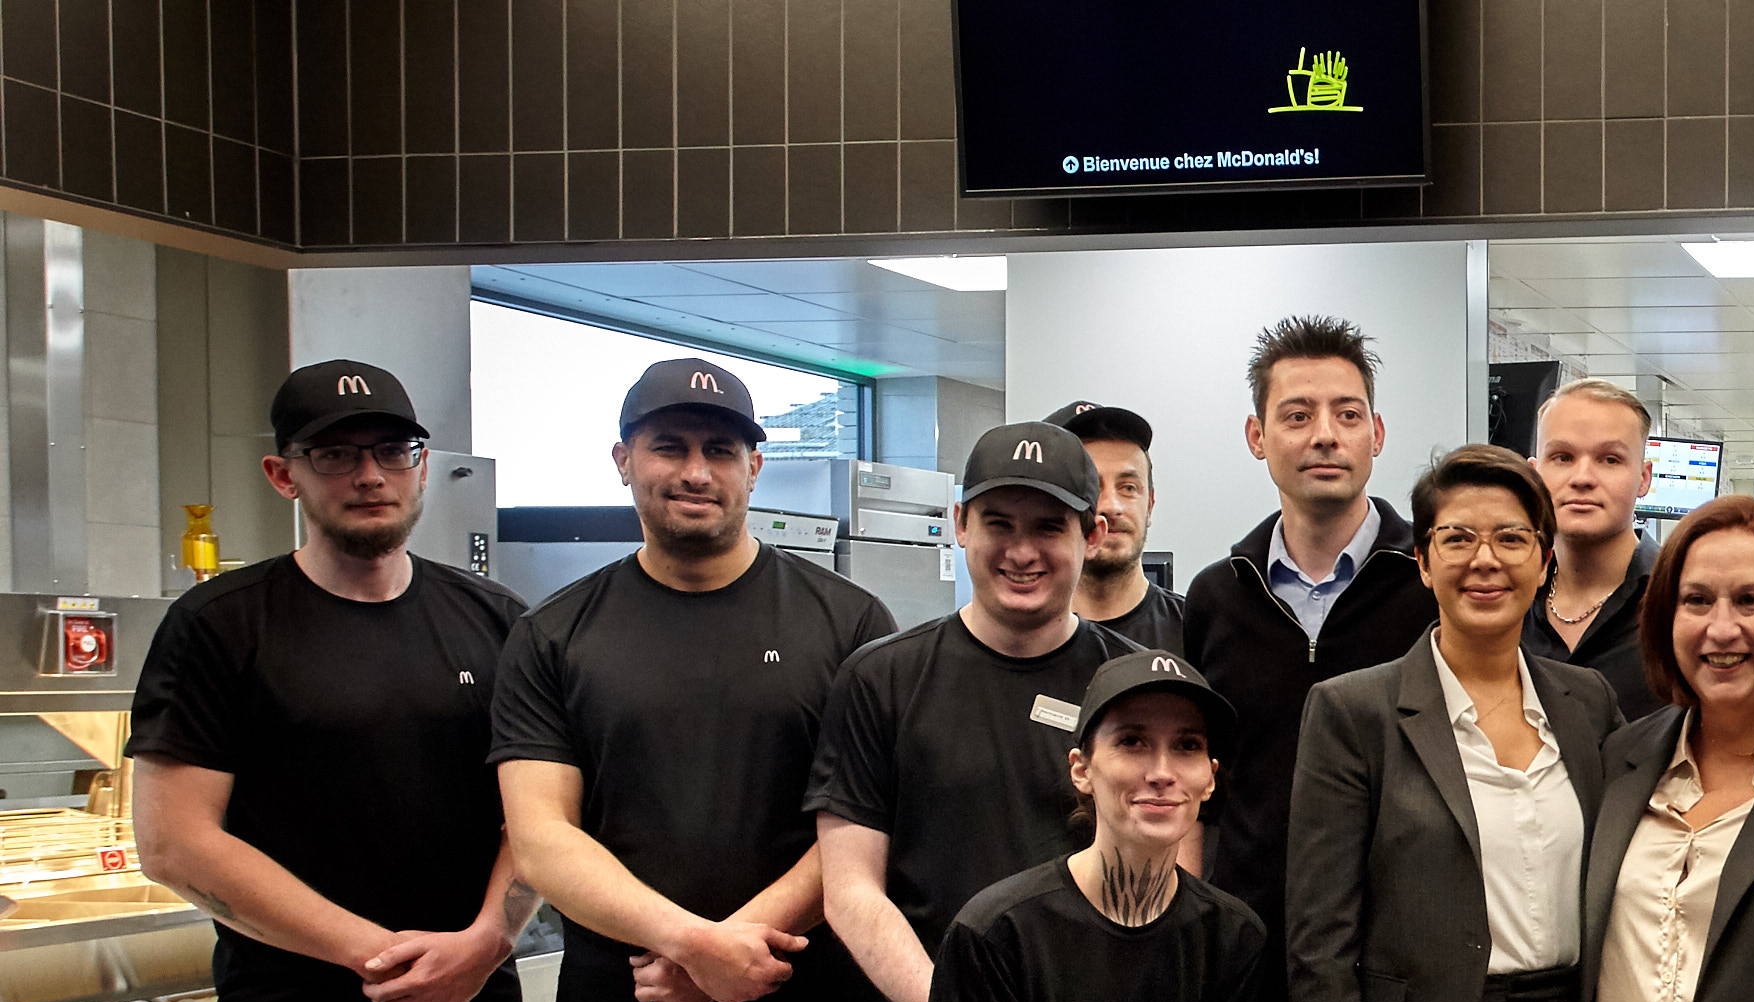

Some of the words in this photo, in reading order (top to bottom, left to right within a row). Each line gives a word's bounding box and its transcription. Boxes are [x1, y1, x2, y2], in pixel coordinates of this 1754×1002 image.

[1083, 156, 1169, 172] Bienvenue
[1174, 153, 1213, 169] chez
[1217, 148, 1319, 167] McDonald's!
